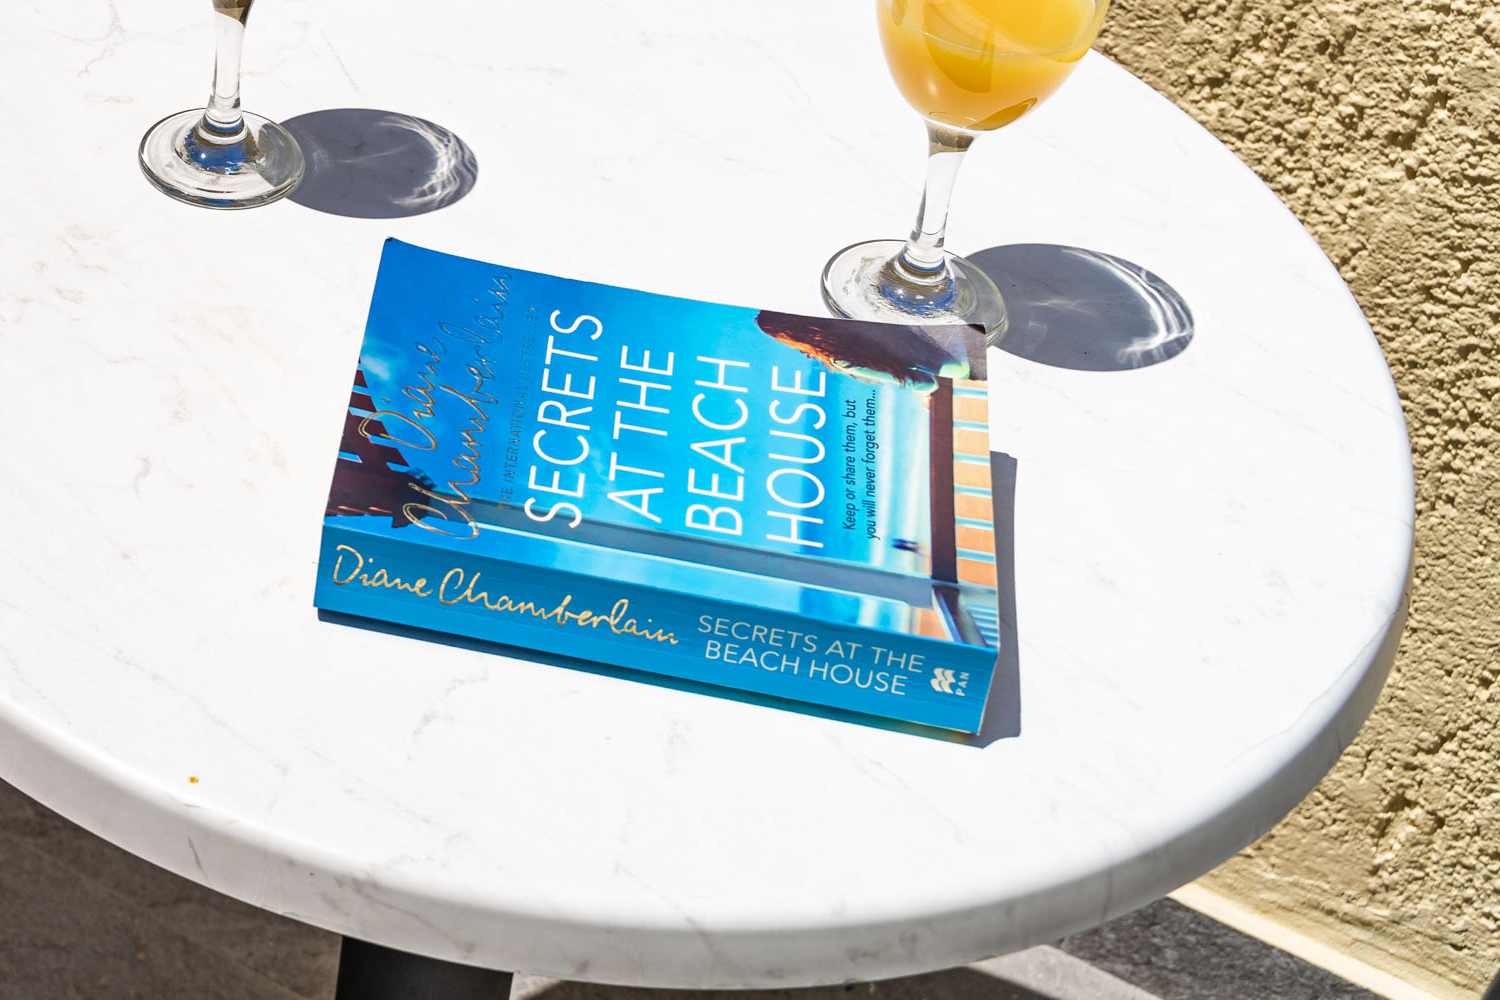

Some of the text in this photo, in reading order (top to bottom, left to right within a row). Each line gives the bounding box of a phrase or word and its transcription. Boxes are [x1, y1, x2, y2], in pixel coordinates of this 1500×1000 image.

[358, 336, 447, 450] Diane
[403, 272, 513, 539] Chamberlain
[503, 386, 528, 481] INTERNATIONAL
[524, 310, 603, 528] SECRETS
[607, 345, 674, 523] AT THE
[685, 356, 750, 535] BEACH
[766, 366, 827, 548] HOUSE
[842, 399, 860, 530] Keep or share them, but
[861, 389, 881, 540] you will never forget them...
[333, 544, 679, 645] Diane Chamberlain
[697, 615, 925, 673] SECRETS AT THE
[705, 640, 908, 695] BEACH HOUSE
[955, 671, 970, 696] PAN
